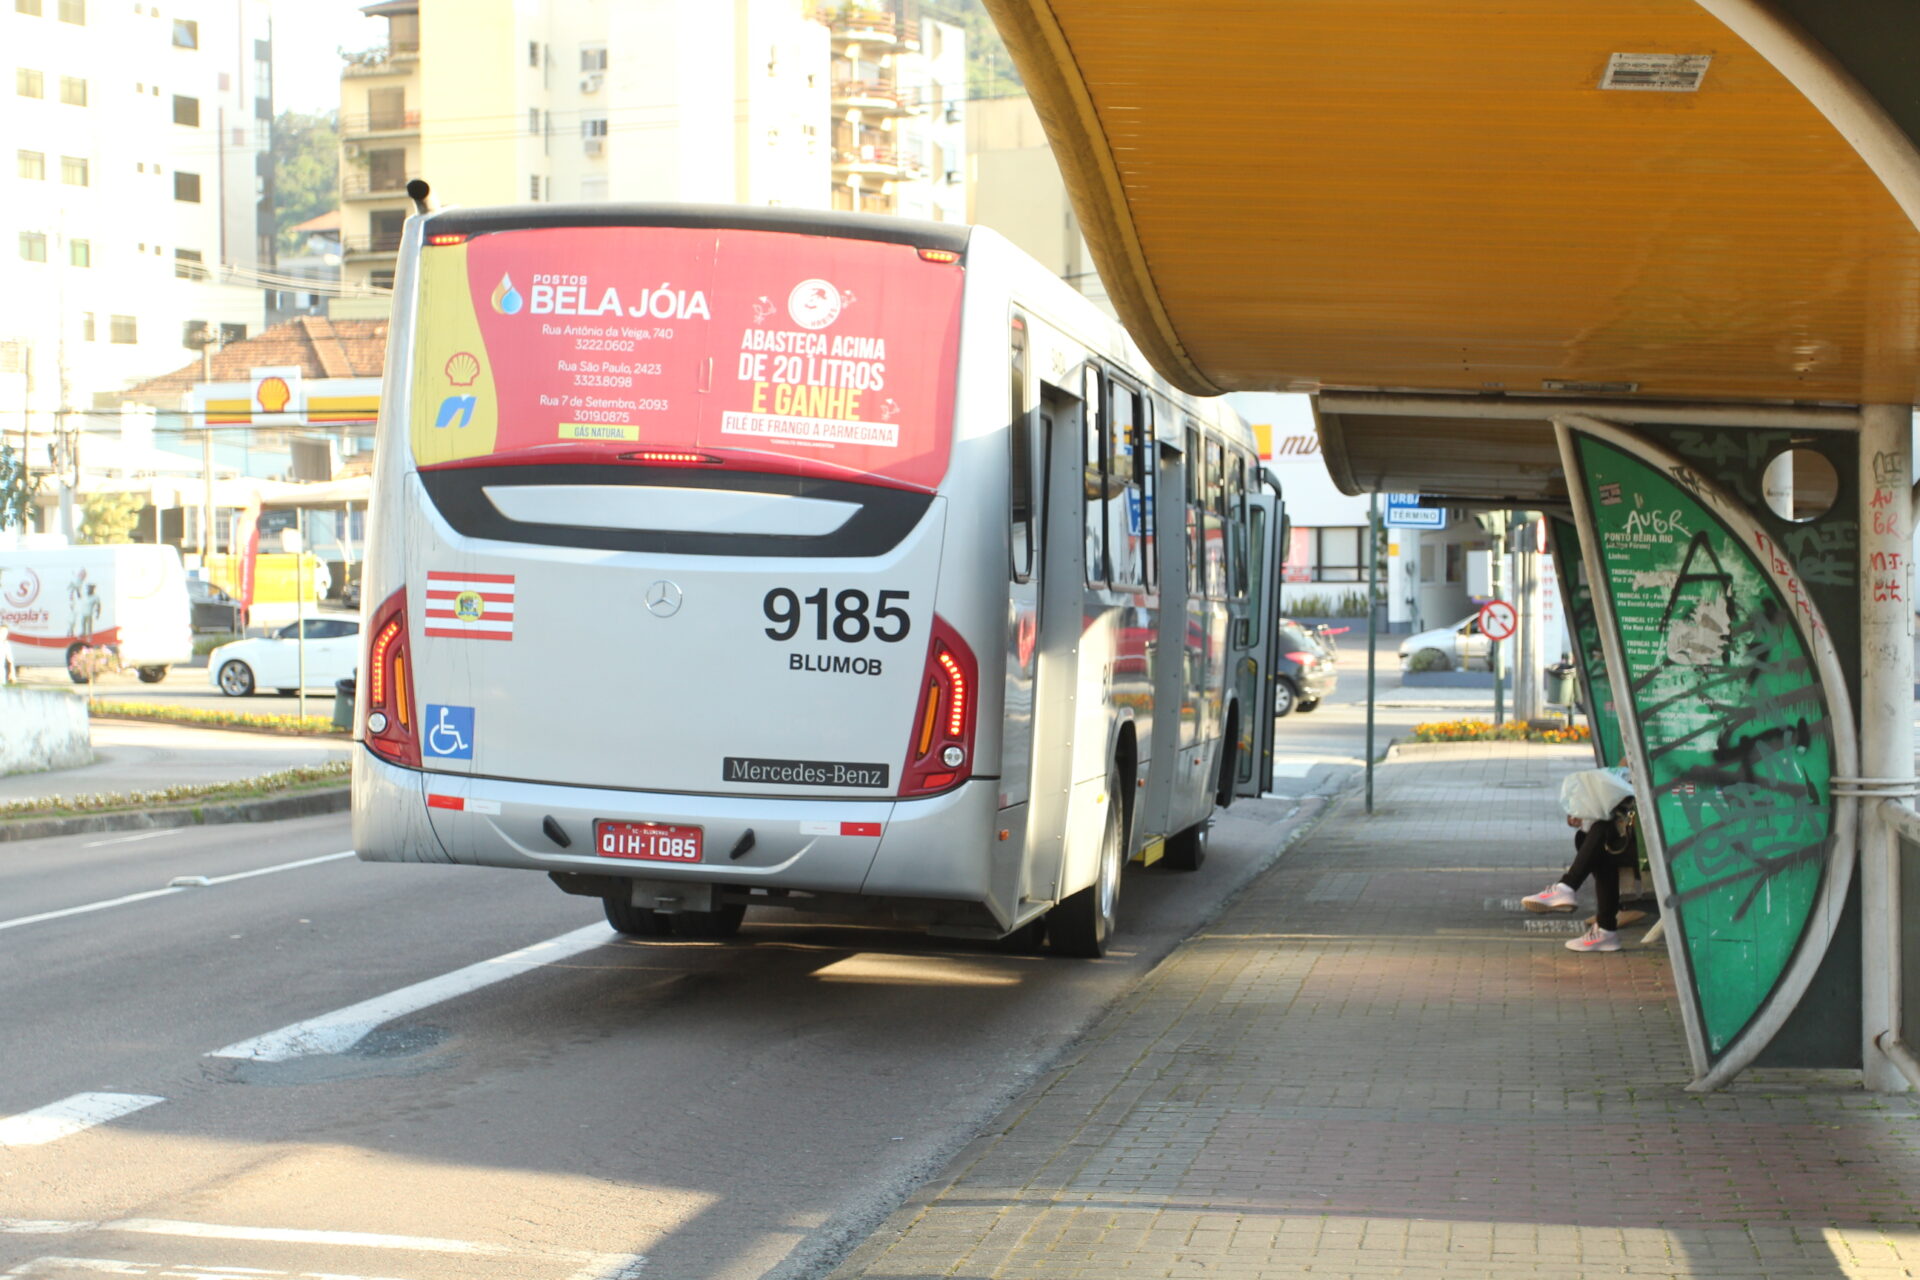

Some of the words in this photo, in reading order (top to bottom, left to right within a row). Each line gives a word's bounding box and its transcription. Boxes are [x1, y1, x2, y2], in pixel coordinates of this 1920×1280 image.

[533, 274, 588, 285] POSTOS
[530, 285, 623, 317] BELA
[629, 282, 711, 320] JÓIA
[542, 324, 561, 335] Rua
[563, 324, 603, 337] Antônio
[605, 326, 619, 337] da
[621, 327, 651, 340] Veiga,
[653, 328, 673, 339] 740
[575, 339, 634, 352] 3222.0602
[741, 328, 827, 358] ABASTEÇA
[830, 335, 886, 360] ACIMA
[558, 360, 577, 371] Rua
[579, 360, 599, 373] São
[602, 362, 632, 375] Paulo,
[634, 363, 662, 375] 2423
[738, 352, 768, 381] DE
[772, 355, 803, 385] 20
[807, 357, 886, 391] LITROS
[573, 375, 632, 388] 3323.8098
[540, 395, 559, 406] Rua
[562, 396, 568, 406] 7
[570, 396, 583, 407] de
[586, 396, 637, 411] Setembro,
[639, 399, 668, 410] 2093
[752, 381, 770, 414] E
[774, 382, 863, 421] GANHE
[573, 410, 630, 423] 3019.0875
[574, 426, 590, 437] GÁS
[591, 427, 625, 439] NATURAL
[725, 414, 748, 431] FILÉ
[751, 417, 764, 432] DE
[767, 419, 811, 436] FRANGO
[823, 423, 893, 442] PARMEGIANA
[1604, 532, 1631, 542] PONTO
[1633, 533, 1657, 543] BEIRA
[1659, 534, 1673, 543] RIO
[763, 587, 911, 643] 9185
[789, 653, 883, 676] BLUMOB
[731, 760, 881, 785] Mercedes-Benz
